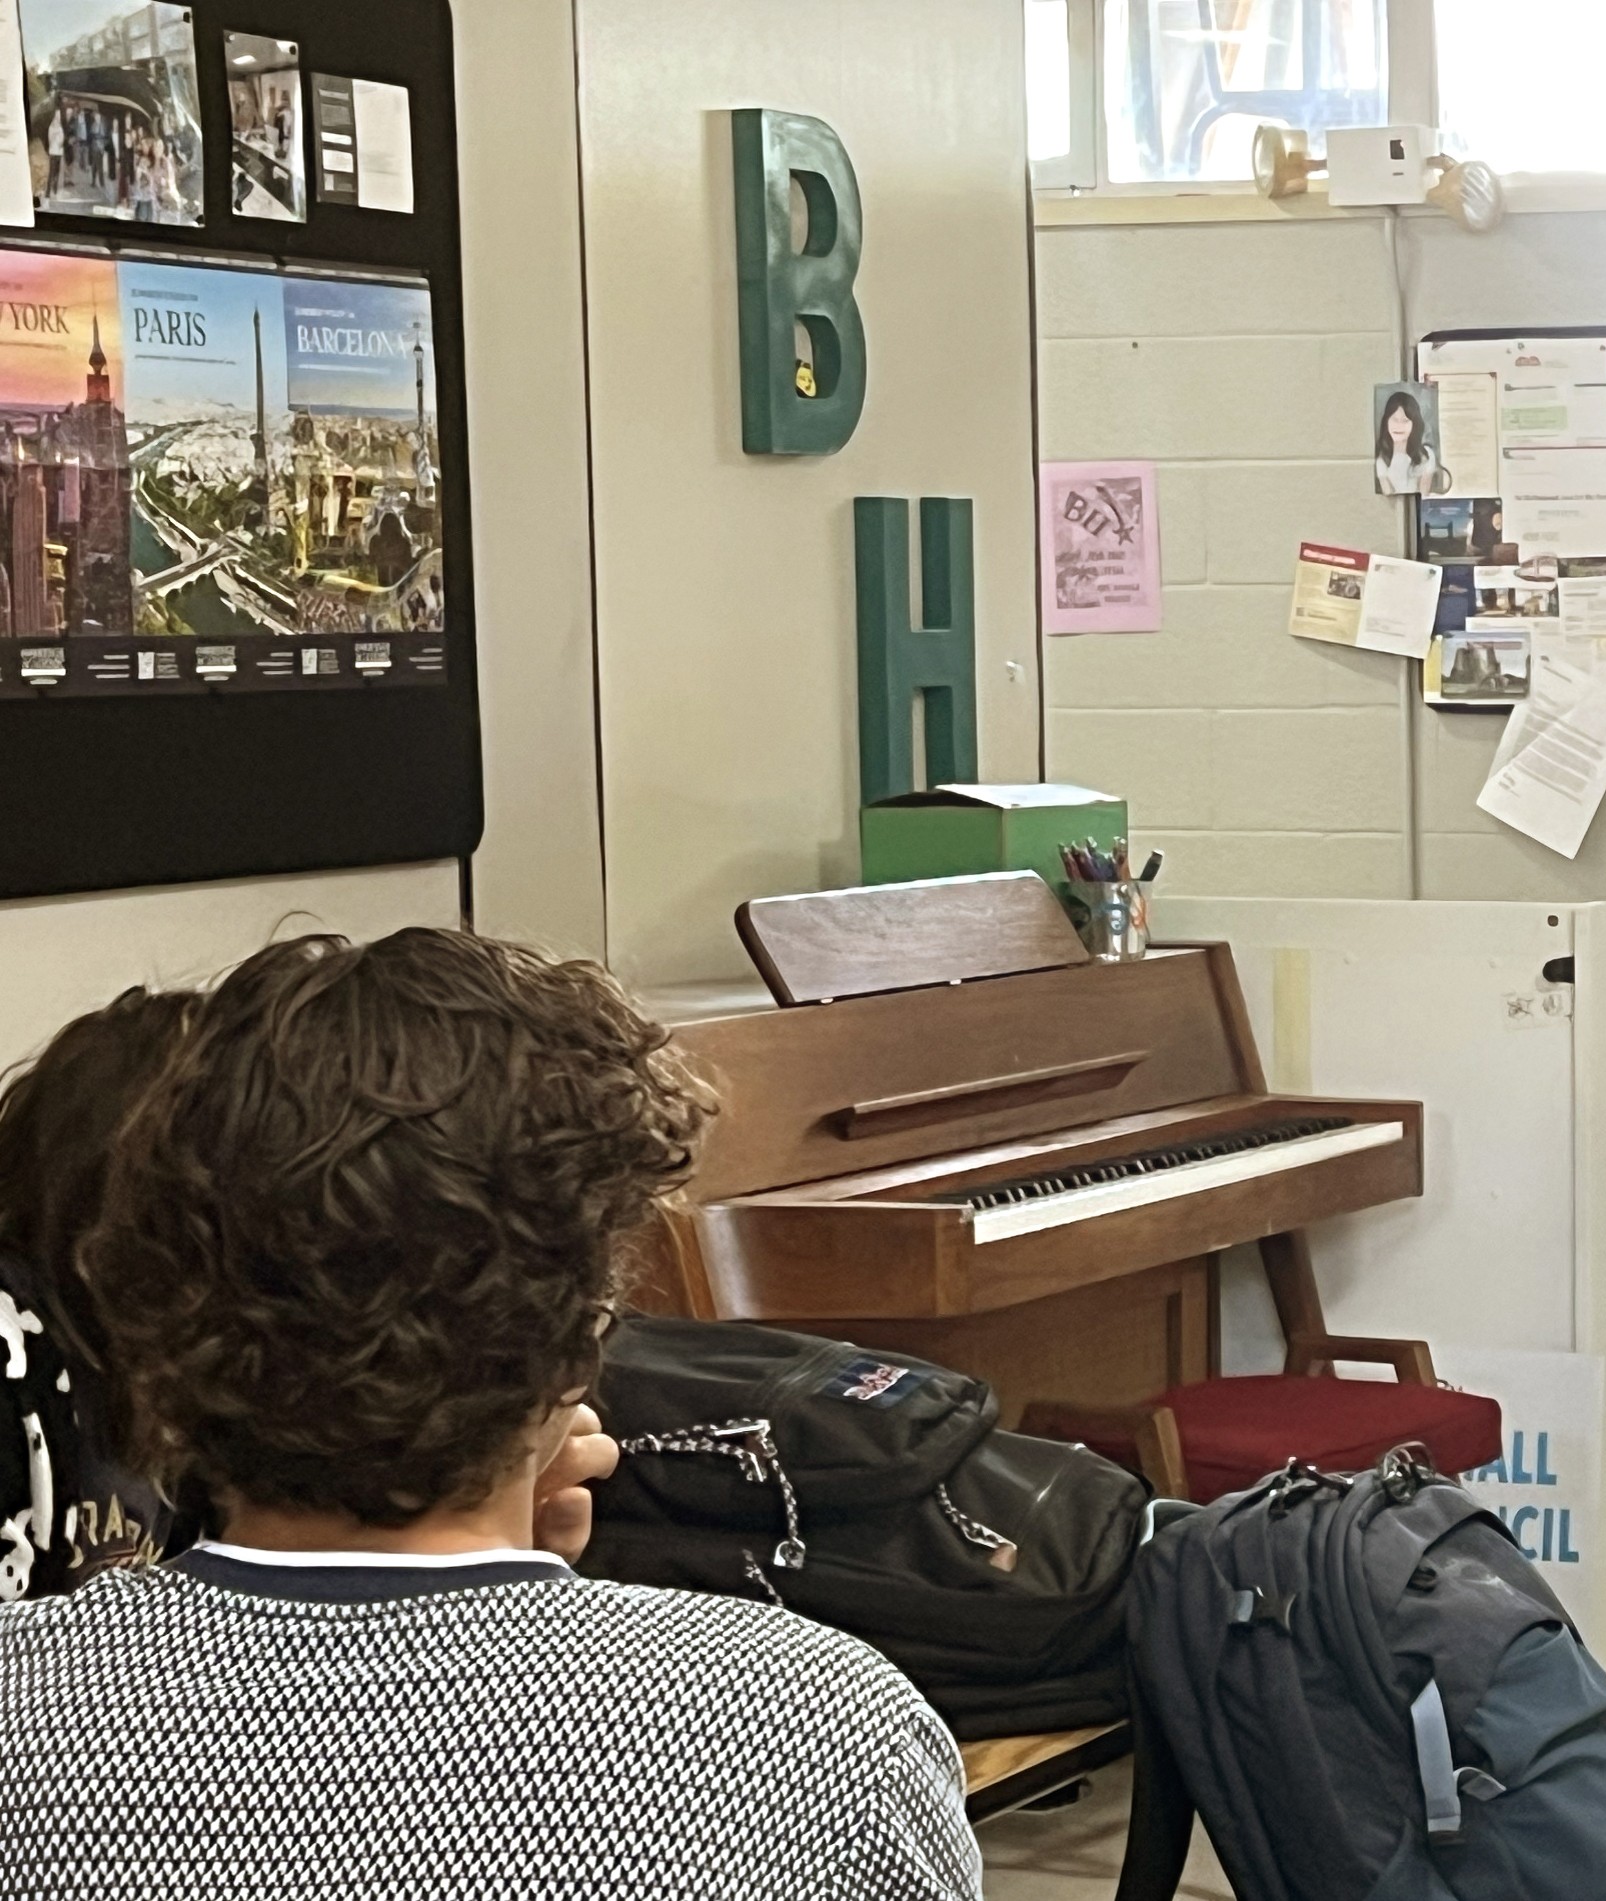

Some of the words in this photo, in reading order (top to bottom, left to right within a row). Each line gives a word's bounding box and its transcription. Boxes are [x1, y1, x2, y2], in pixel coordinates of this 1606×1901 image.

[730, 107, 868, 456] B
[9, 301, 71, 335] YORK
[133, 306, 207, 347] PARIS
[296, 323, 408, 360] BARCELONA
[852, 495, 979, 803] H
[1499, 1505, 1580, 1563] CIL
